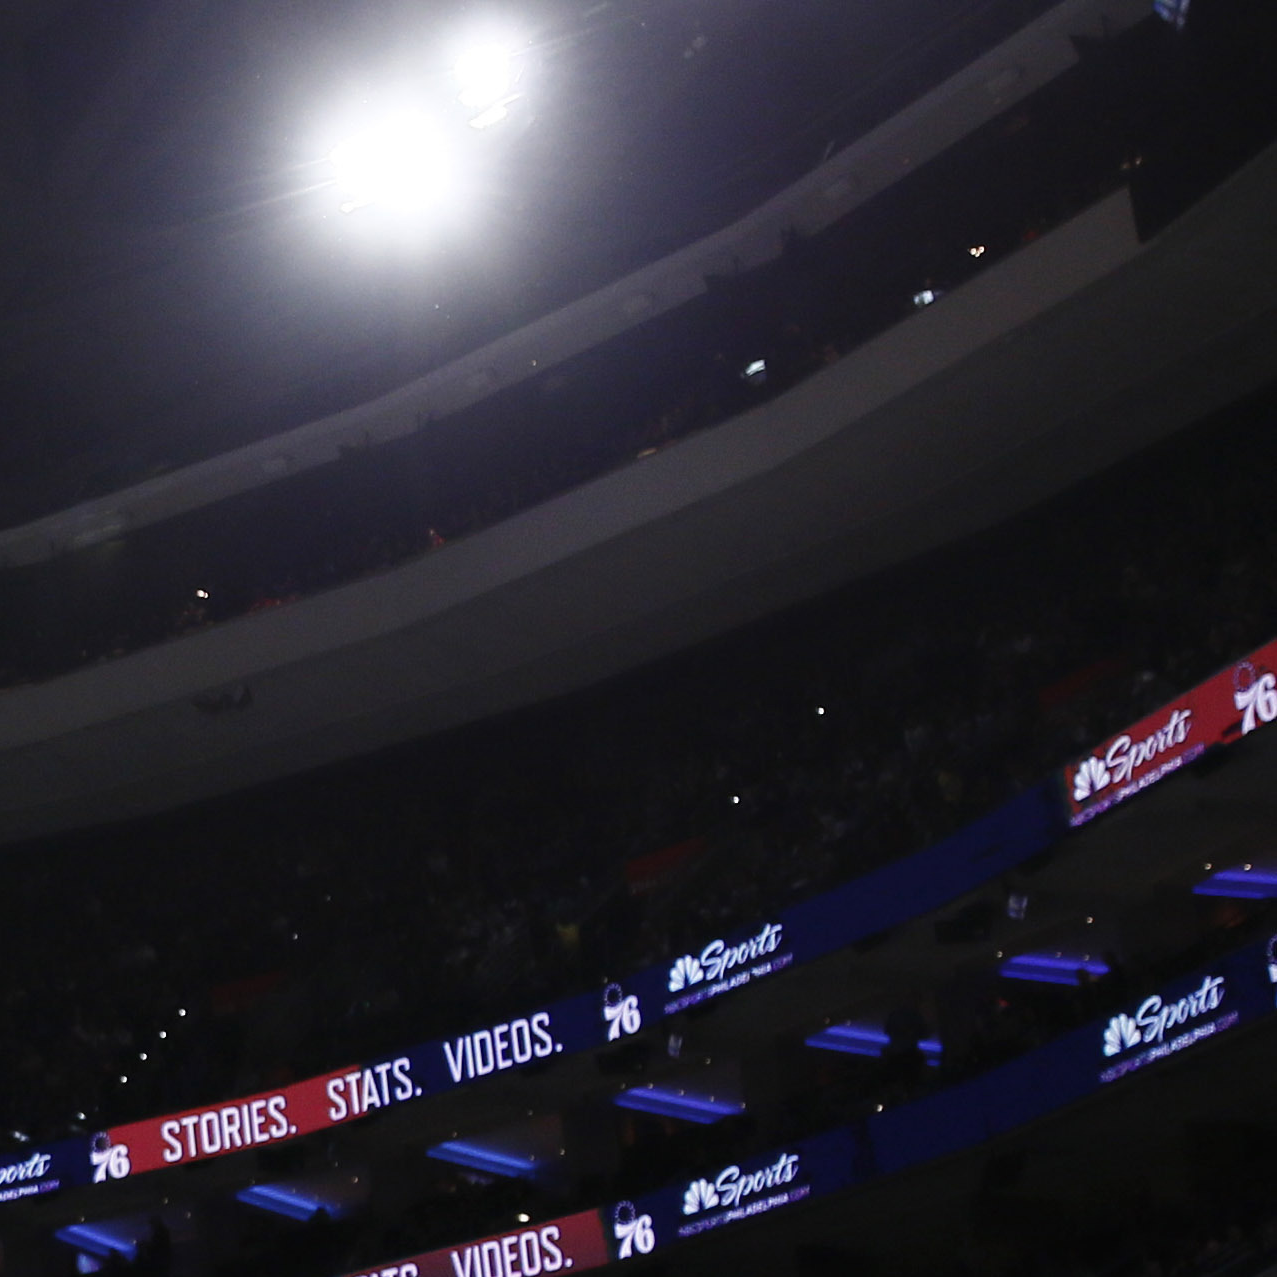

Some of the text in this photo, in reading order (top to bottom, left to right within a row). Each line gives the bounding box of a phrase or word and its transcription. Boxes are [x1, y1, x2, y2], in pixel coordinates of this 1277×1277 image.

[1106, 709, 1191, 784] Sports
[444, 922, 783, 1083] VIDEOS. 76 Sports
[1136, 975, 1225, 1043] Sports
[91, 1145, 130, 1184] 76
[161, 1096, 297, 1163] STORIES.
[327, 1057, 423, 1121] STATS.
[614, 1215, 655, 1259] 76
[715, 1152, 799, 1207] Sports
